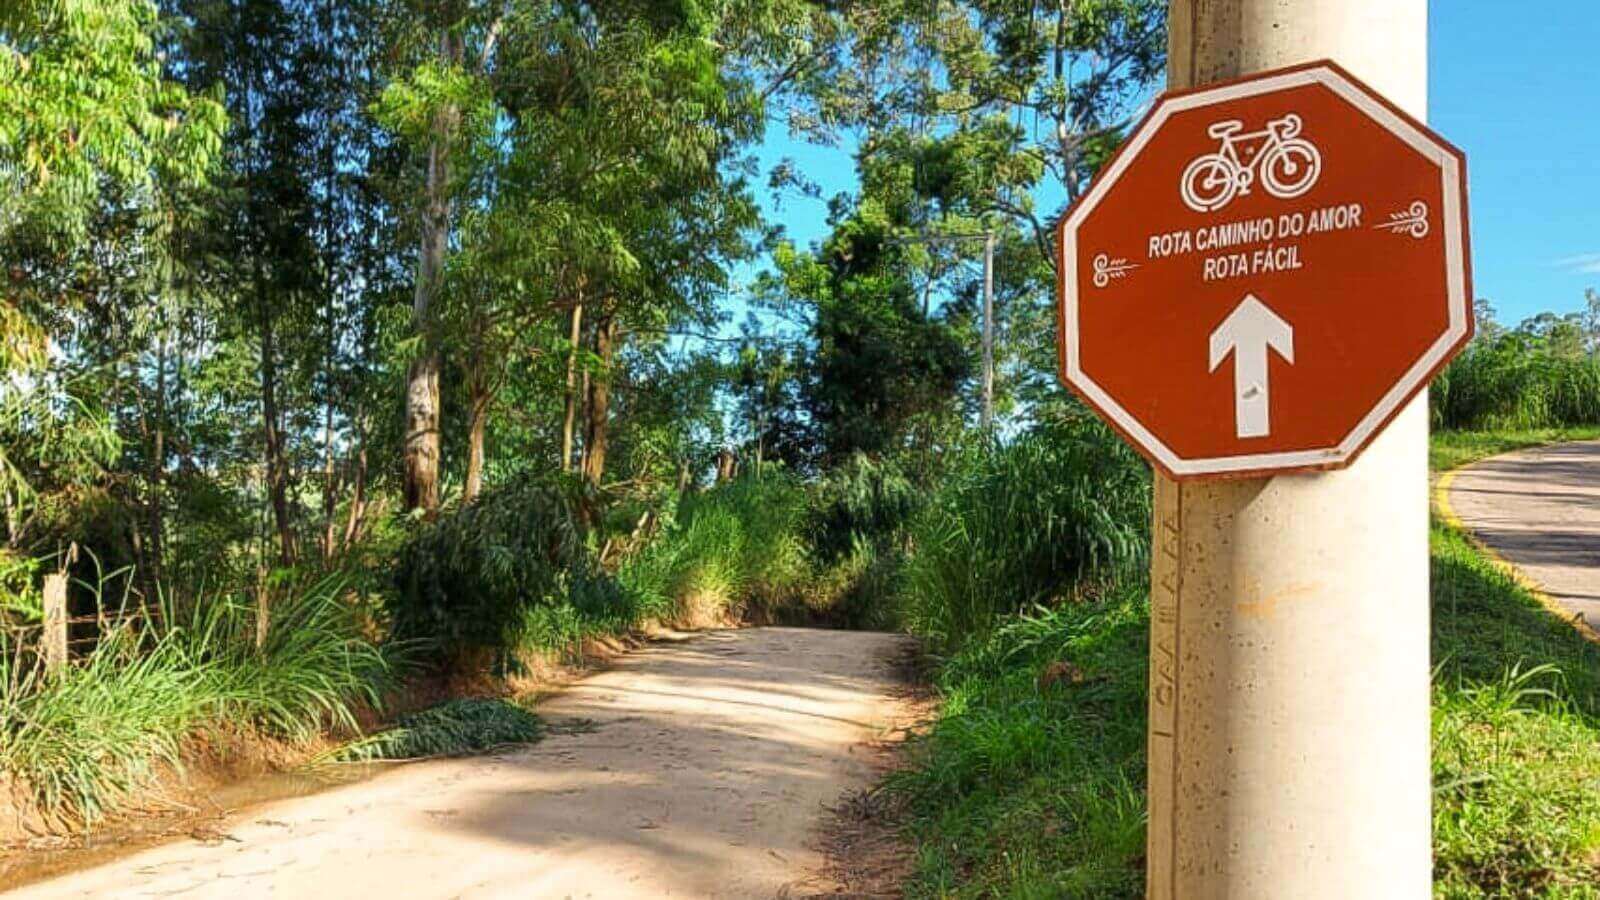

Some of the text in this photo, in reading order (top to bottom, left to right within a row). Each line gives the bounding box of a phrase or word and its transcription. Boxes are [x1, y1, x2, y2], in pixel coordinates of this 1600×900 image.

[1149, 204, 1361, 257] ROTA CAMINHO DO AMOR
[1203, 244, 1302, 280] ROTA FÁCIL
